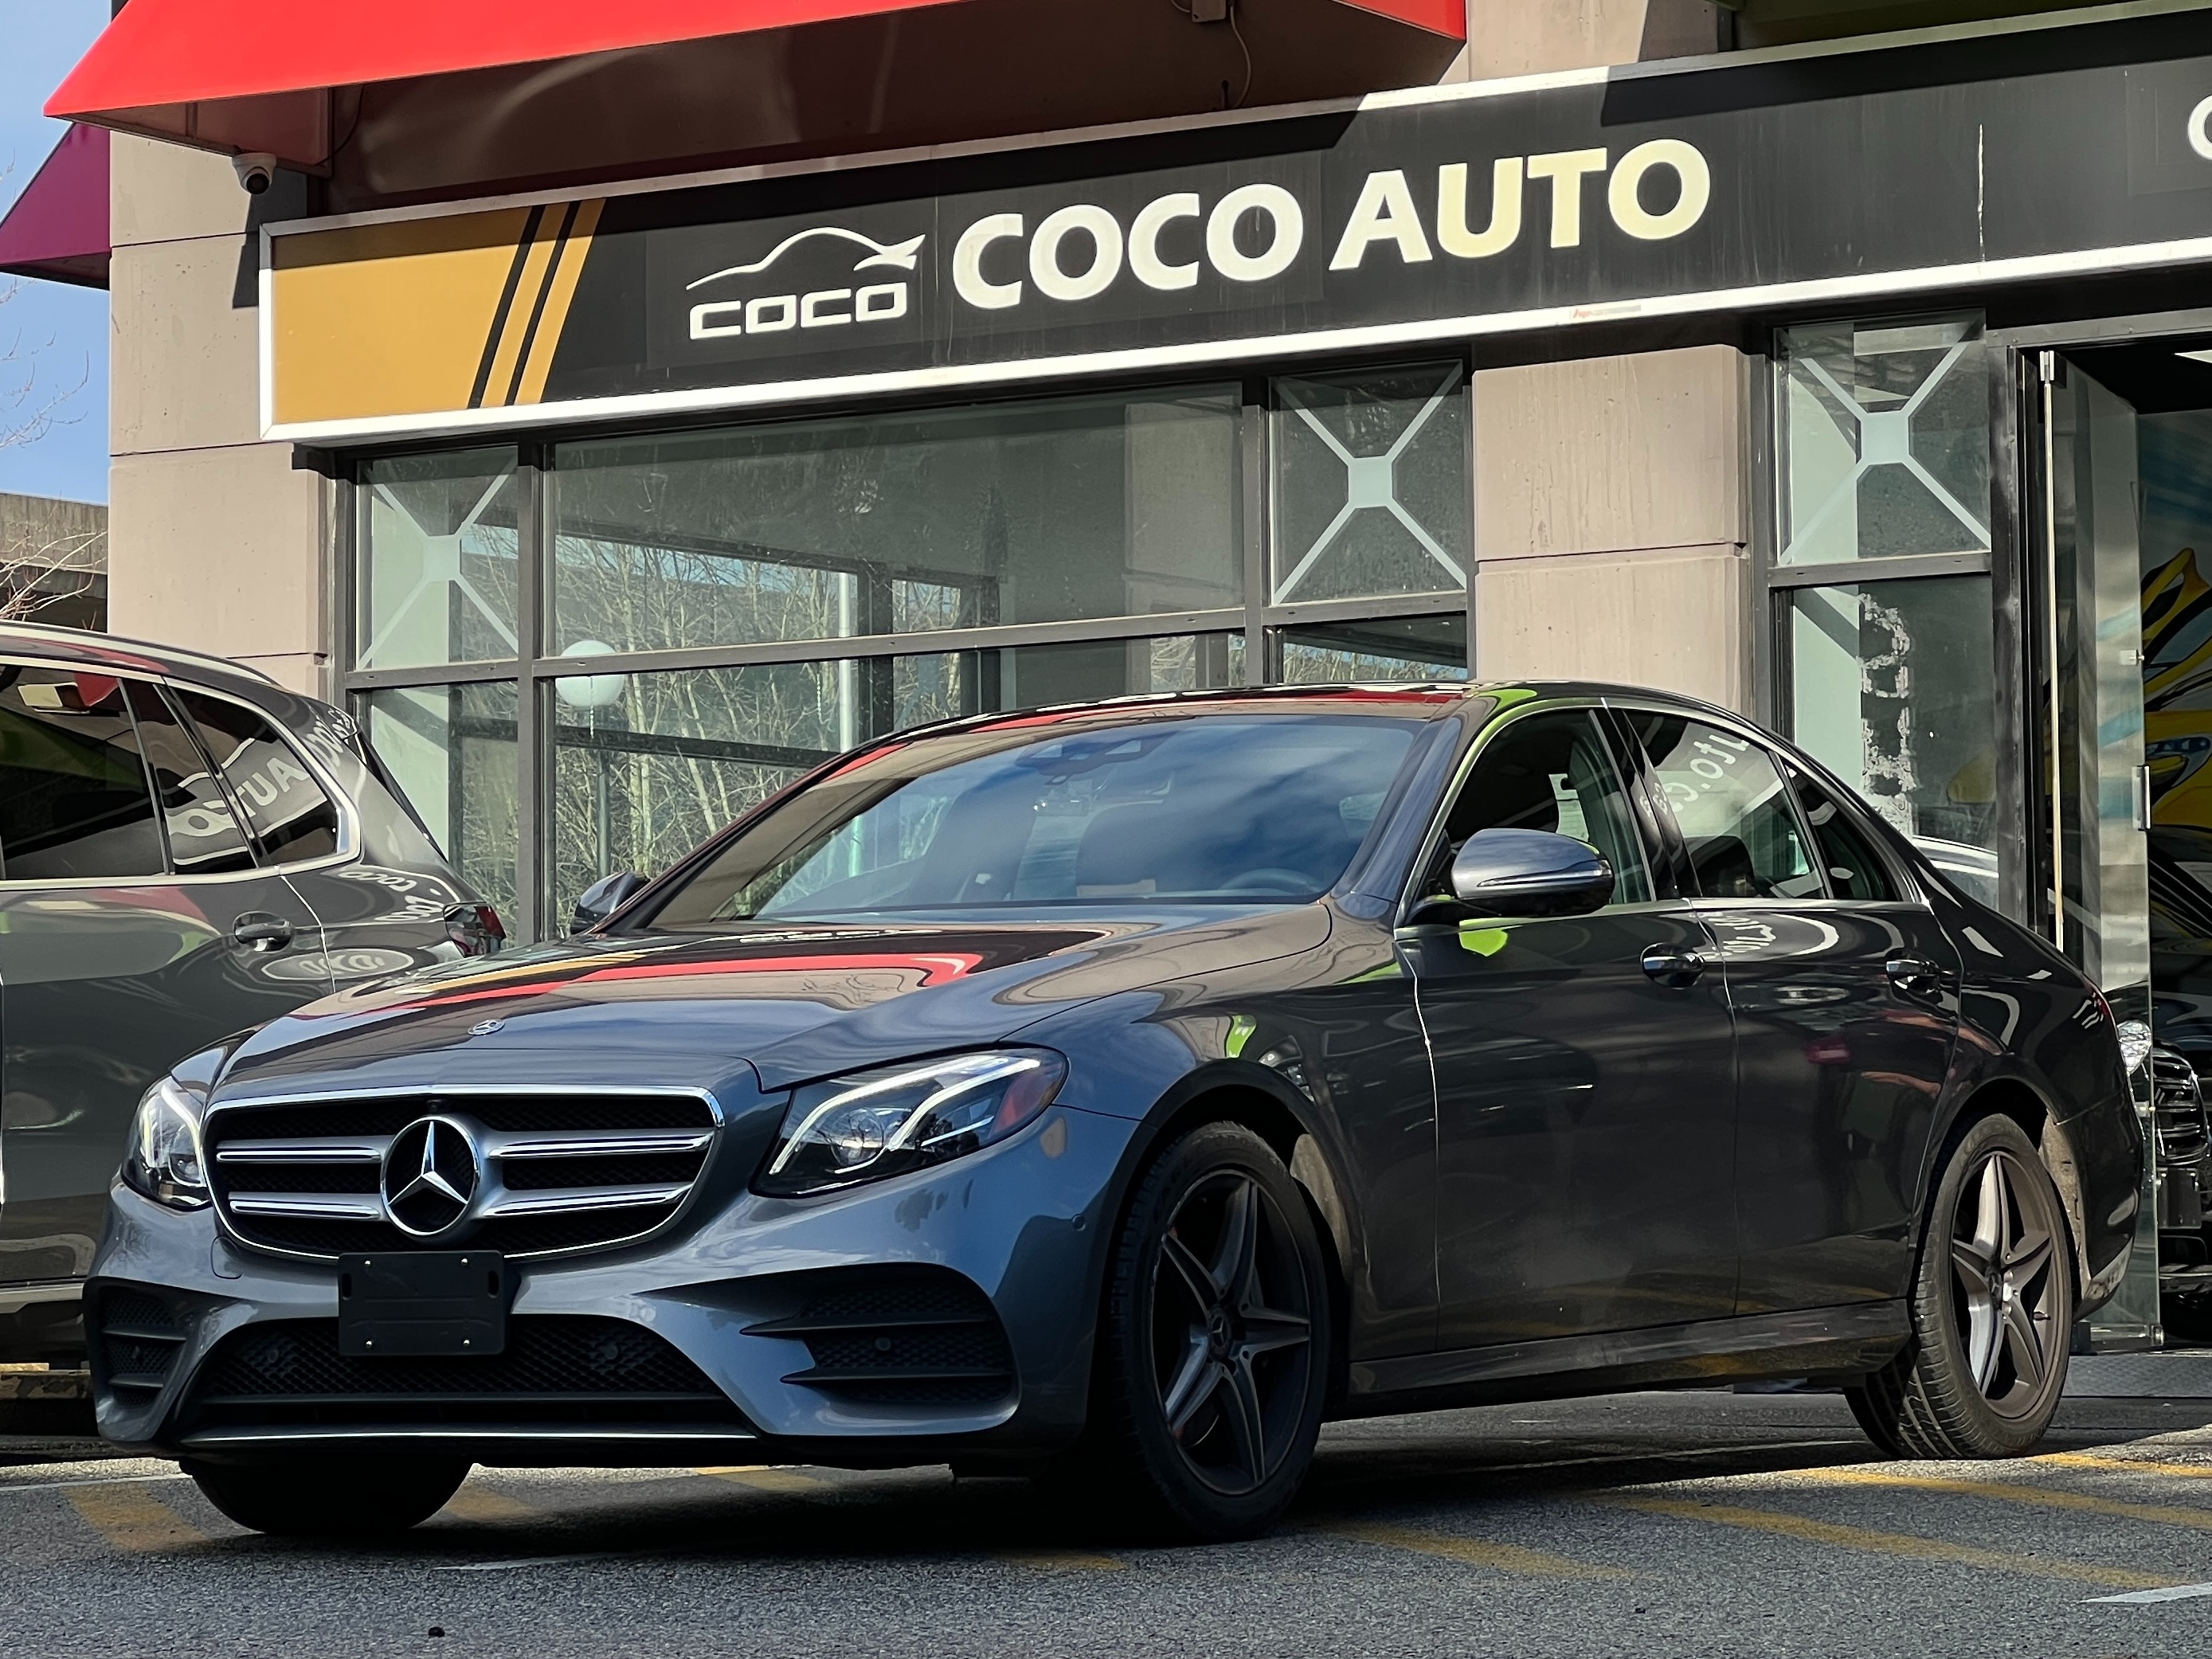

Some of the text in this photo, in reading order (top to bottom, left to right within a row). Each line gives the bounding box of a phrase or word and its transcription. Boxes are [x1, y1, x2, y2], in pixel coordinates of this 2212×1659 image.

[953, 139, 1711, 310] COCO AUTO
[689, 282, 907, 340] COCO
